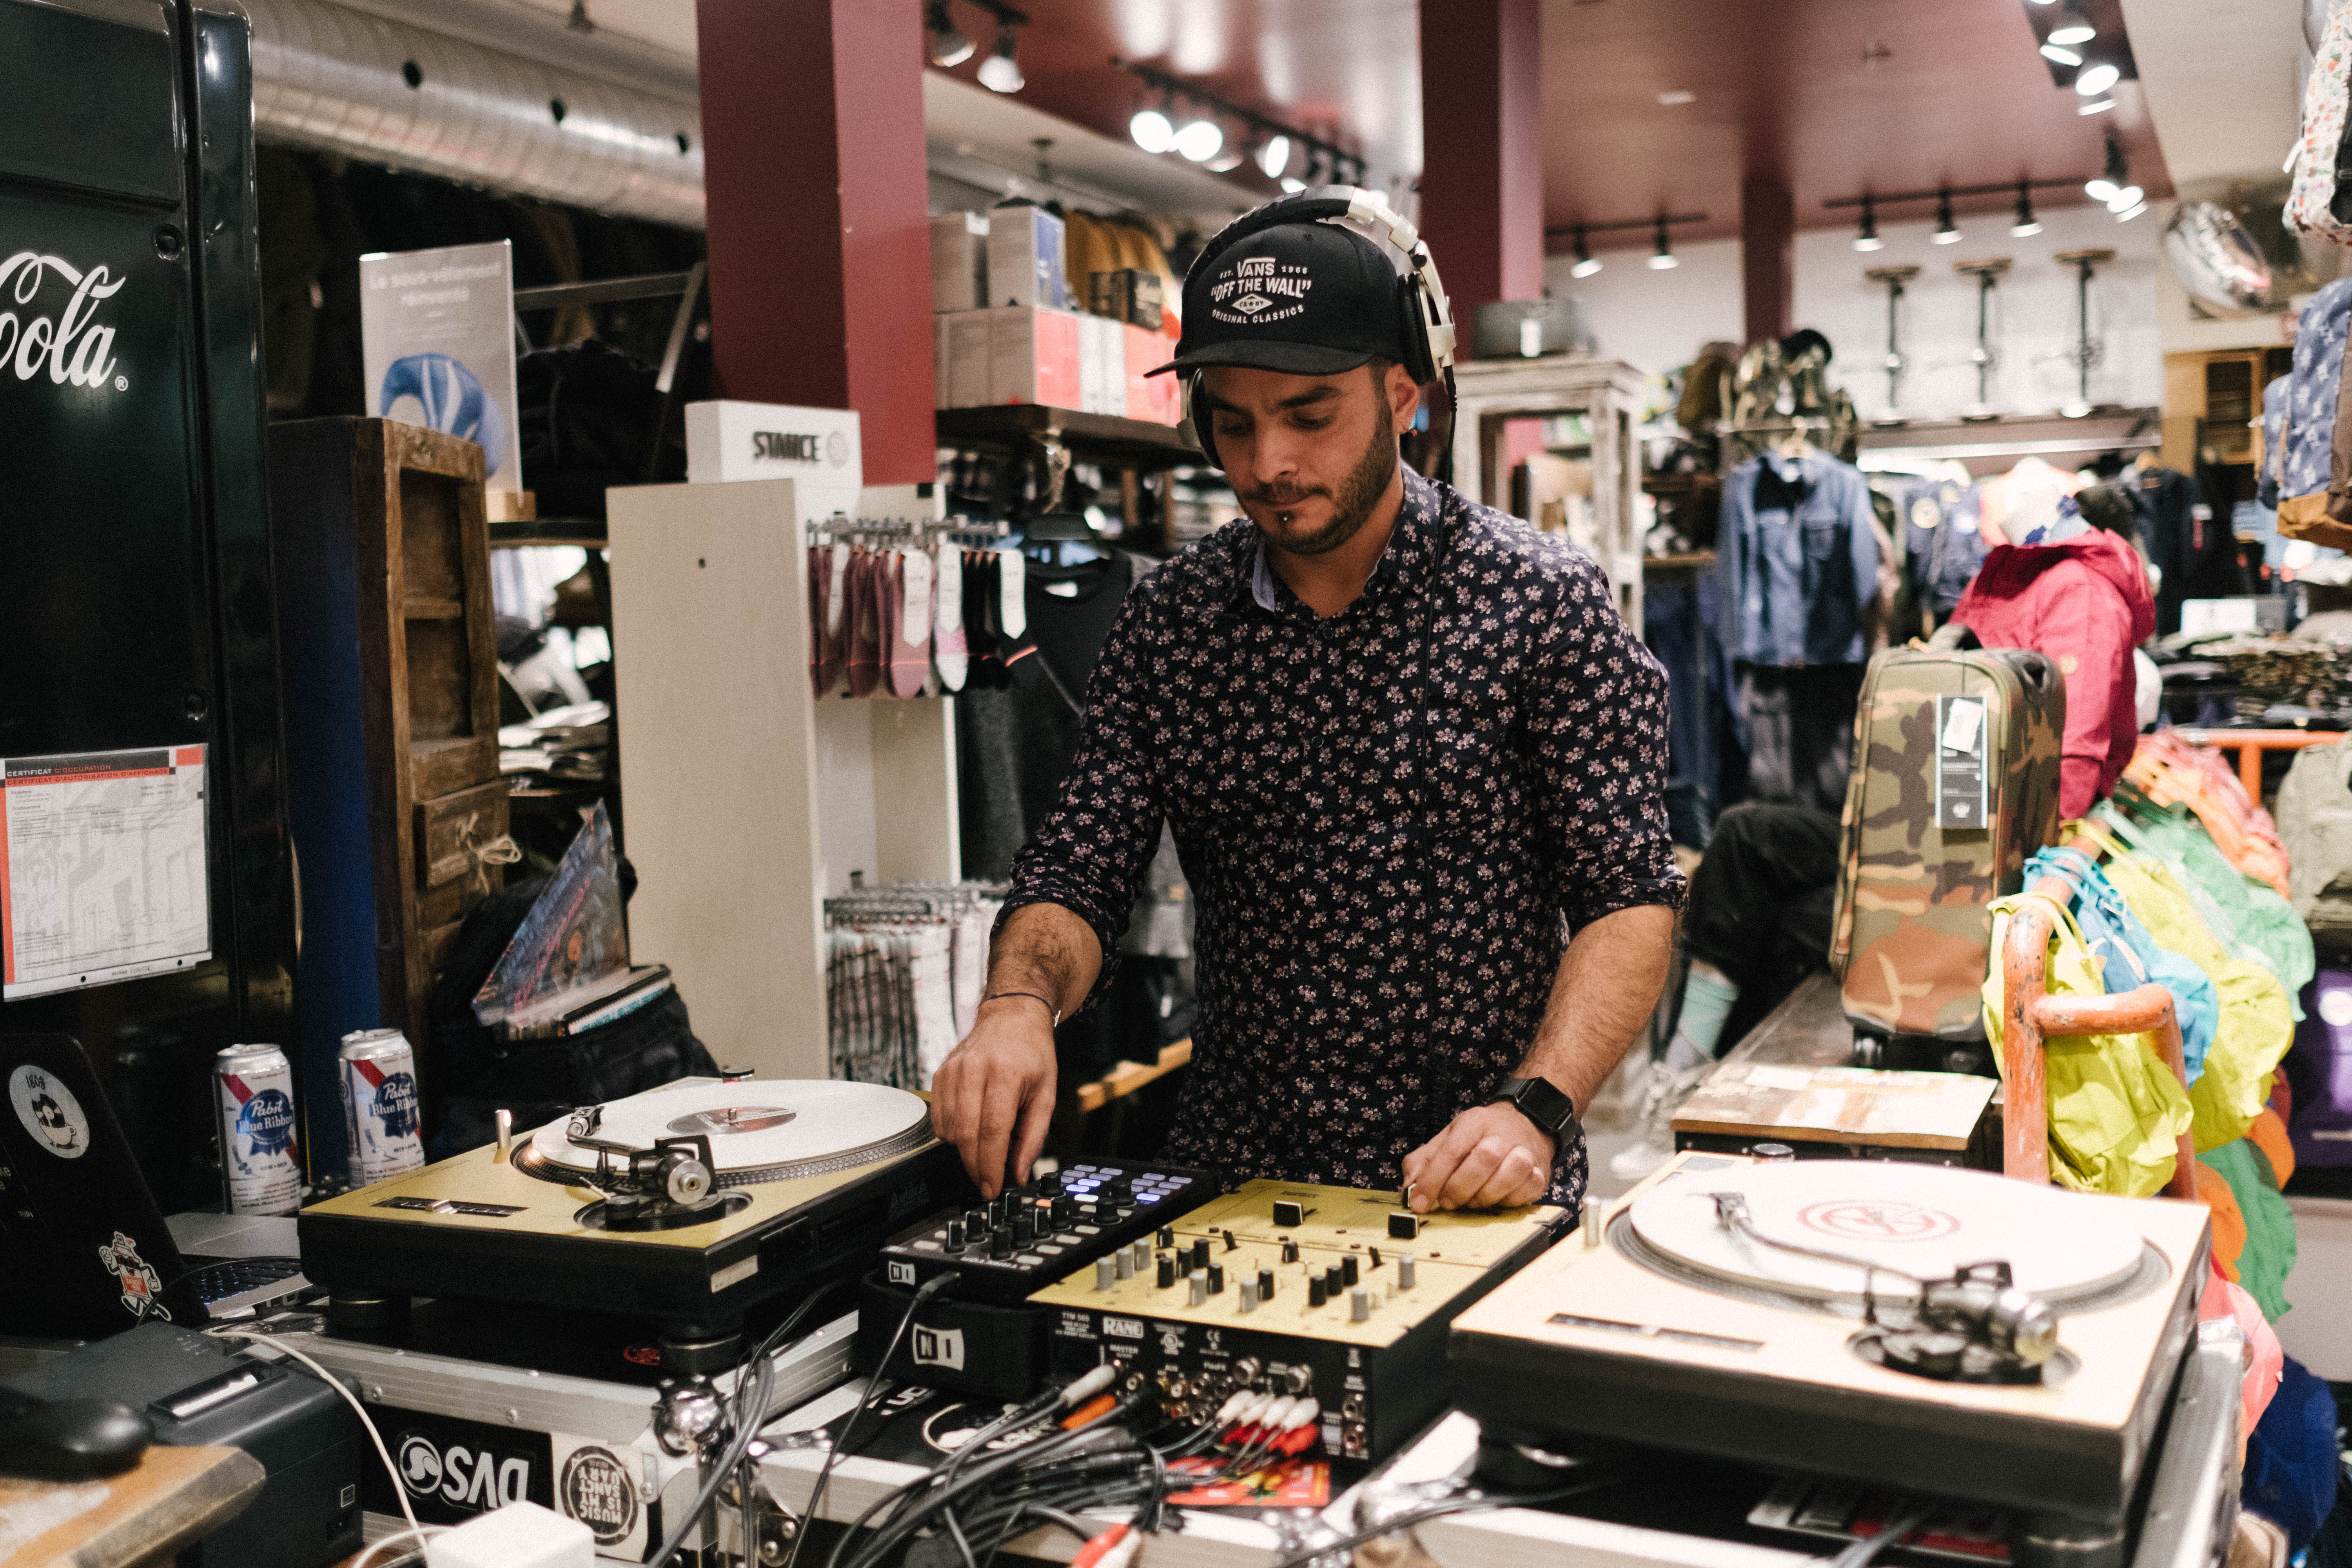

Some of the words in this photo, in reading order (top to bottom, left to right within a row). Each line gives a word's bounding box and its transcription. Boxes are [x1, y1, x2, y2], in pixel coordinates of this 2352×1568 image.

[1220, 270, 1233, 279] EST.
[1237, 257, 1276, 278] VANS
[1281, 265, 1308, 274] 1966
[1238, 278, 1261, 294] THE
[1212, 309, 1247, 324] ORIGINAL
[1253, 304, 1304, 323] CLASSICS
[7, 769, 52, 777] CERTIFICAT
[54, 765, 111, 774] D'OCCUPATION
[7, 777, 52, 786] CERTIFICAT
[55, 772, 118, 782] D'AUTORISATION
[121, 768, 168, 777] D'AFFICHAGE
[383, 1082, 412, 1101] Pabst
[250, 1099, 283, 1118] Pabst
[373, 1103, 396, 1116] Blue
[240, 1119, 263, 1133] Blue
[443, 1445, 529, 1509] DVS
[577, 1466, 620, 1485] UARY
[579, 1479, 620, 1499] SANCT
[579, 1492, 600, 1508] MY
[607, 1497, 621, 1512] IS
[579, 1505, 622, 1524] MUSIC
